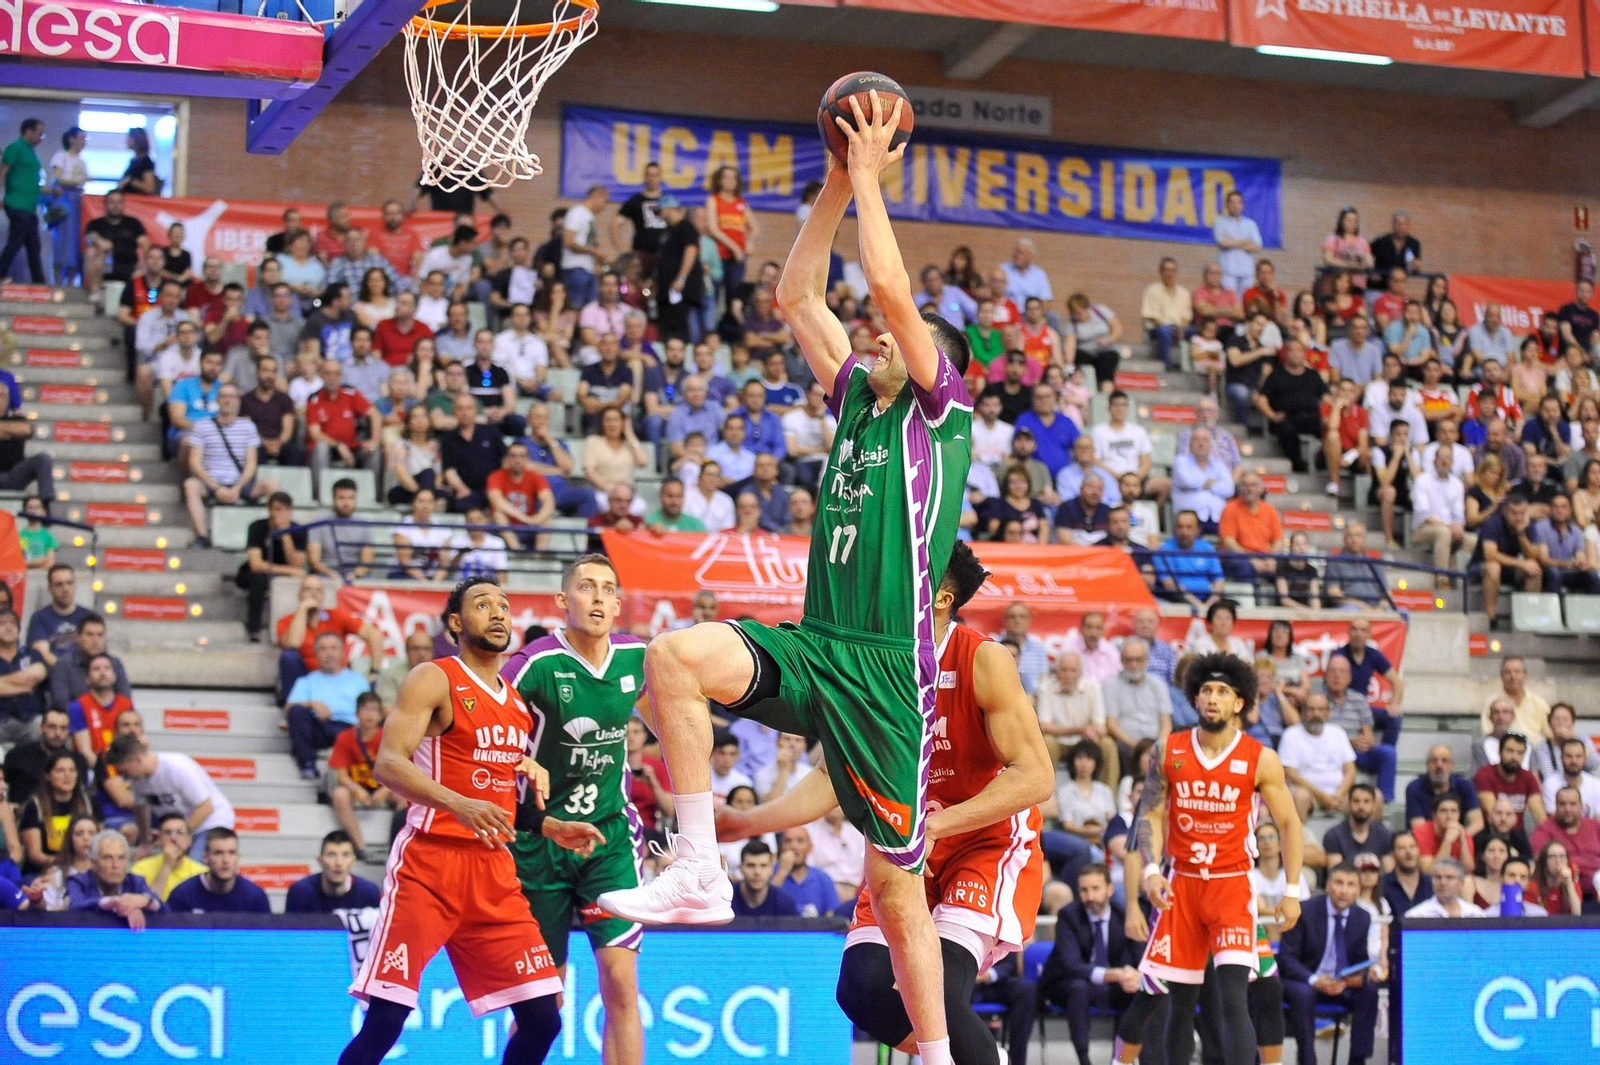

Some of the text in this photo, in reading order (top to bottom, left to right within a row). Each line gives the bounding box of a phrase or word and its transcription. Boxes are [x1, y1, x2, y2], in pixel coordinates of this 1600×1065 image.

[1452, 7, 1567, 37] LEVANTE
[973, 101, 1043, 126] Norte
[612, 121, 1236, 228] UCAM IVERSIDAD
[829, 524, 857, 565] 17
[475, 724, 528, 752] UCAM
[564, 783, 598, 815] 33
[1175, 780, 1240, 802] UCAM
[1176, 797, 1237, 813] UNIVERSIDAD
[1189, 841, 1217, 865] 31
[956, 880, 989, 893] GLOBAL
